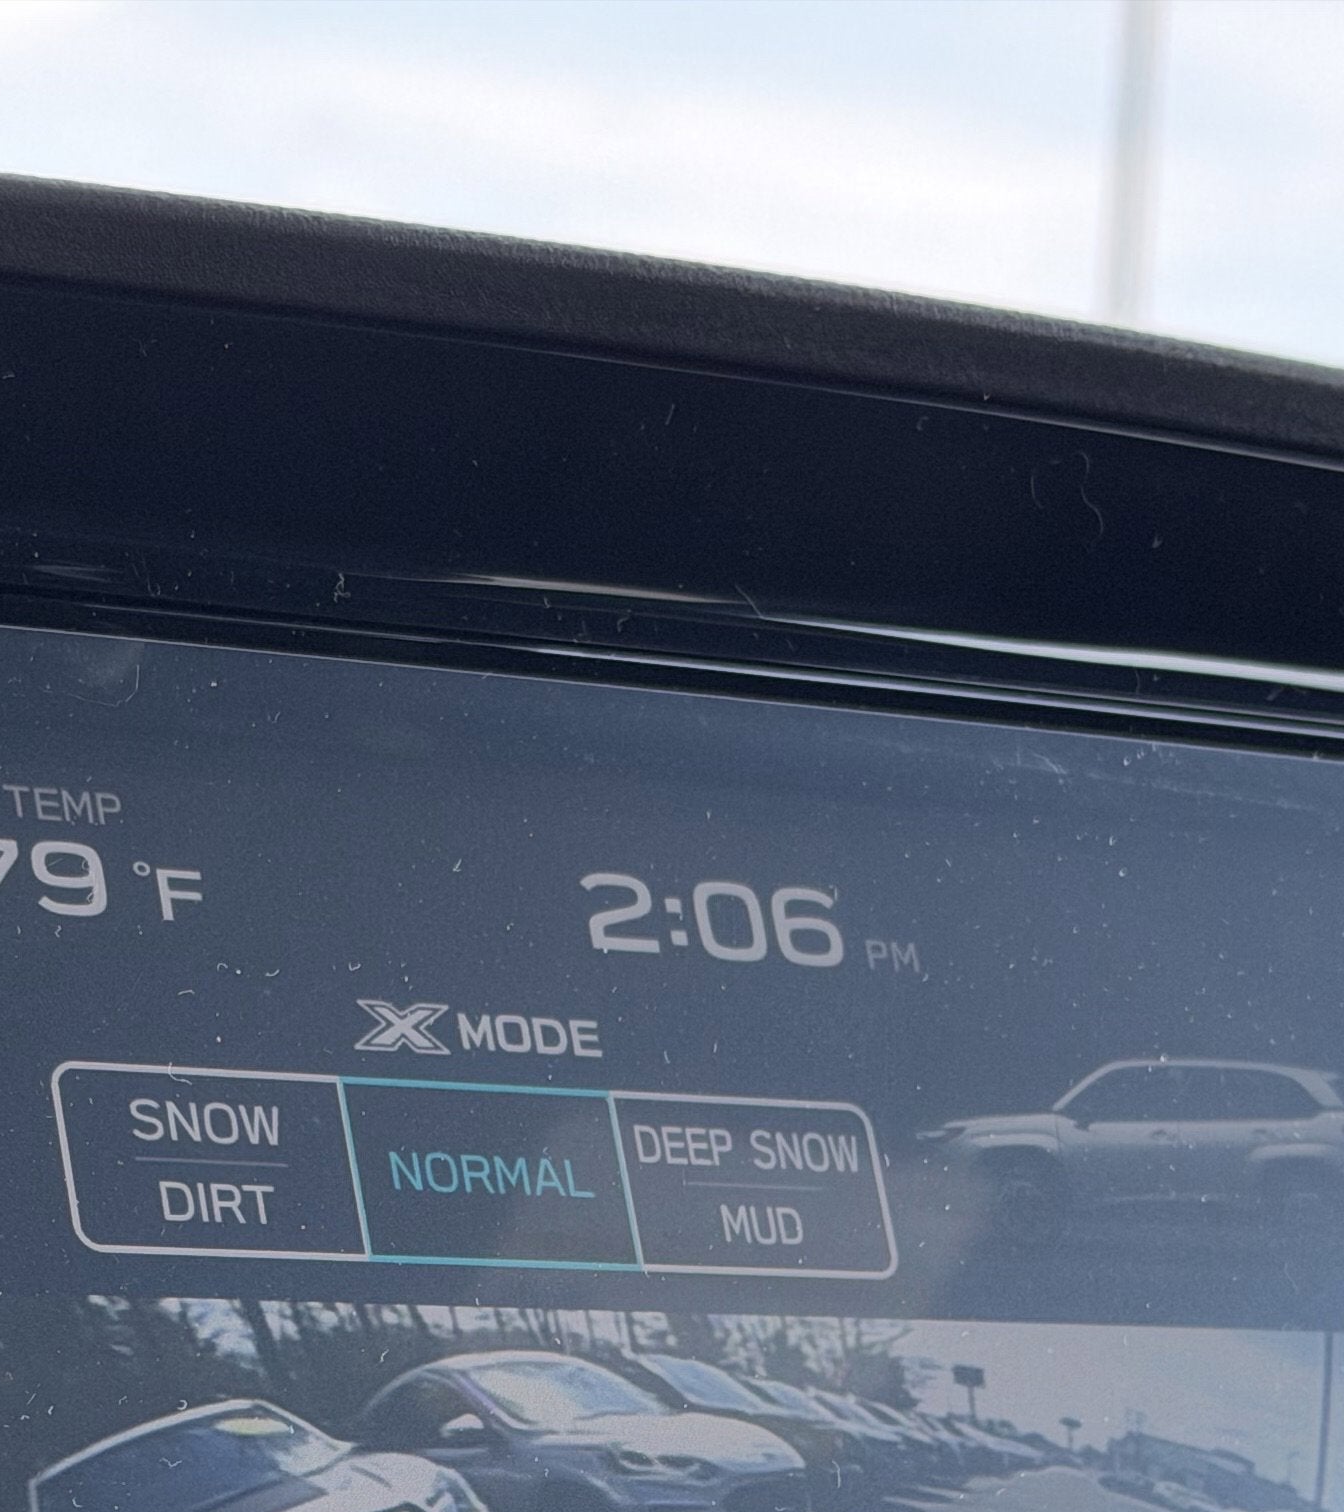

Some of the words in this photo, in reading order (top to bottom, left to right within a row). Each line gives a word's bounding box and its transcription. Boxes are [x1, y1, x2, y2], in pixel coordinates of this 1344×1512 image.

[3, 785, 122, 827] TEMP
[580, 871, 846, 968] 2:06
[864, 939, 921, 975] PM
[457, 1012, 604, 1059] MODE
[128, 1097, 282, 1146] SNOW
[632, 1123, 733, 1168] DEEP
[750, 1130, 859, 1173] SNOW
[388, 1149, 596, 1199] NORMAL
[159, 1179, 276, 1226] DIRT
[718, 1204, 804, 1246] MUD
